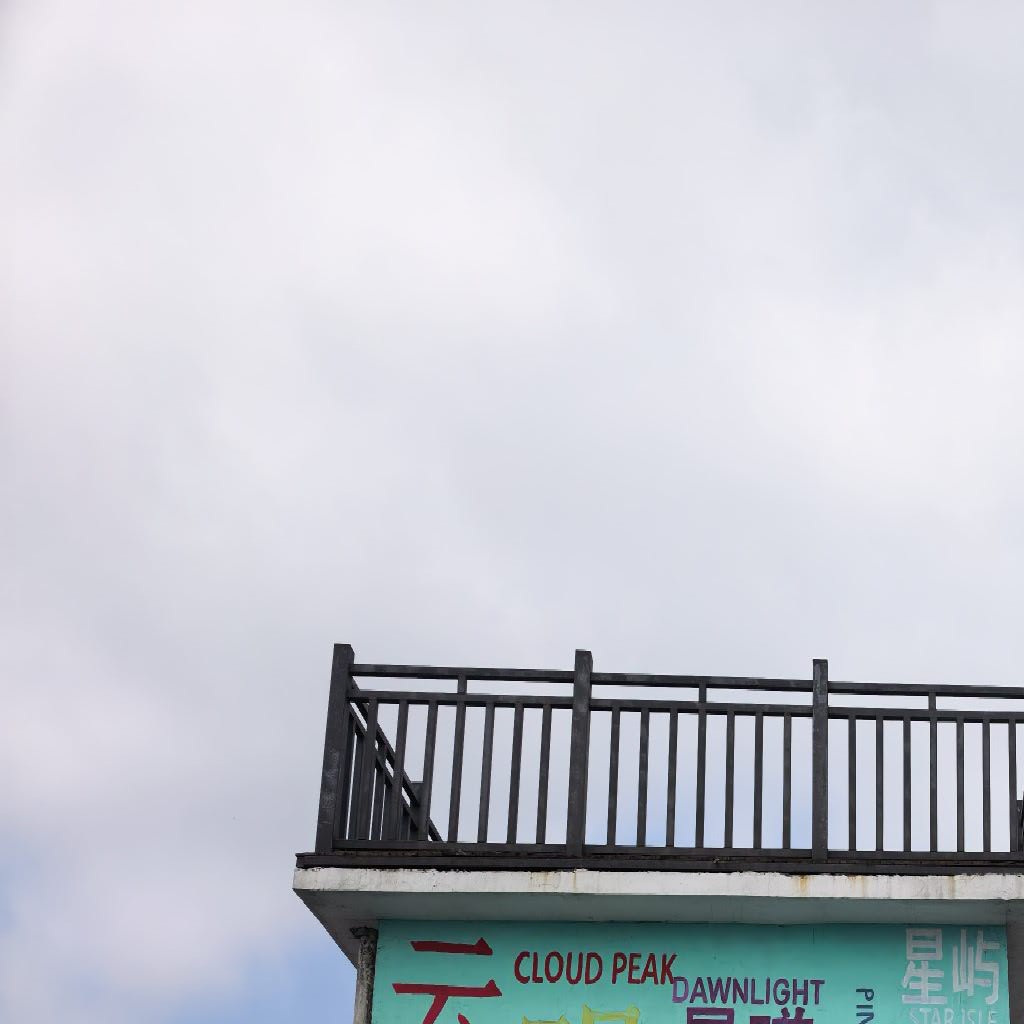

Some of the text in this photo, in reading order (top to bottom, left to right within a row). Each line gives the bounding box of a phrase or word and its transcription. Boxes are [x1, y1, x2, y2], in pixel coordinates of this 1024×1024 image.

[514, 951, 678, 985] CLOUD PEAK
[901, 927, 1000, 1006] 星屿
[672, 976, 825, 1006] DAWNLIGHT
